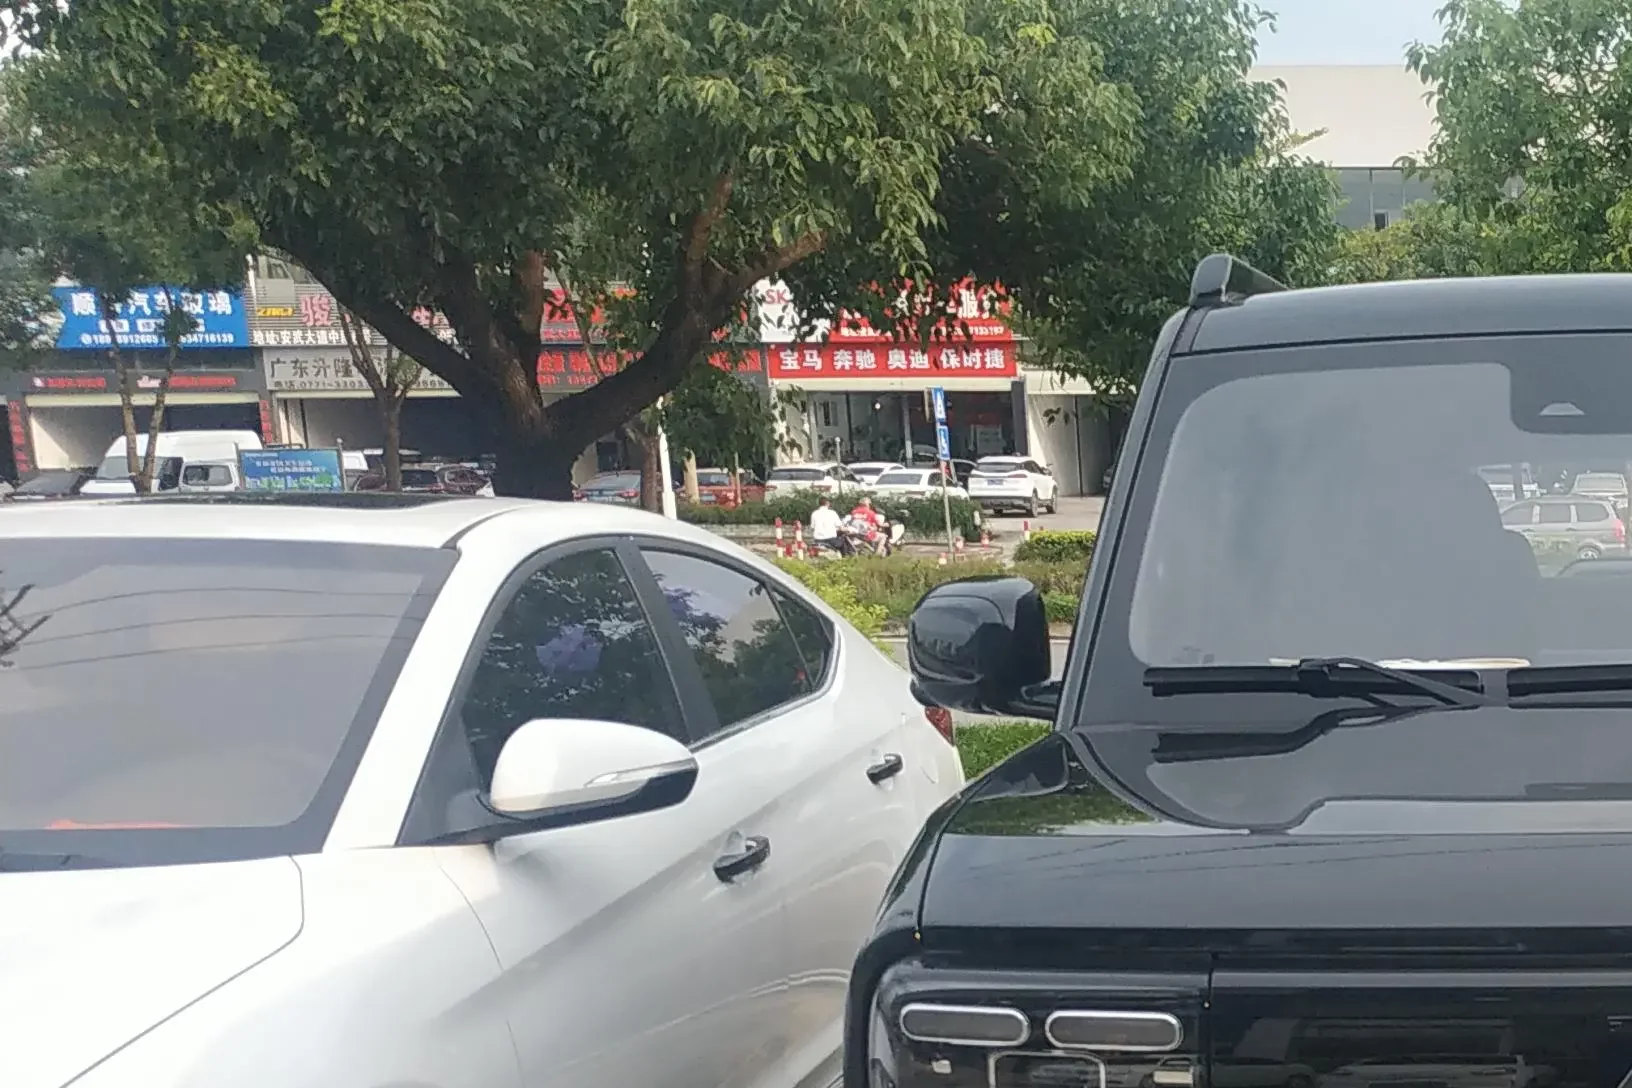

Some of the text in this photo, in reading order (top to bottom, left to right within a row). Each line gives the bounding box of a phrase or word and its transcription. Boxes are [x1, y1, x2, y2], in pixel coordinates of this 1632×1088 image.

[71, 289, 233, 316] 顺汽车玻璃
[780, 350, 823, 370] 宝马
[833, 350, 877, 370] 奔驰
[887, 350, 931, 370] 奥迪
[940, 349, 1006, 370] 保时捷
